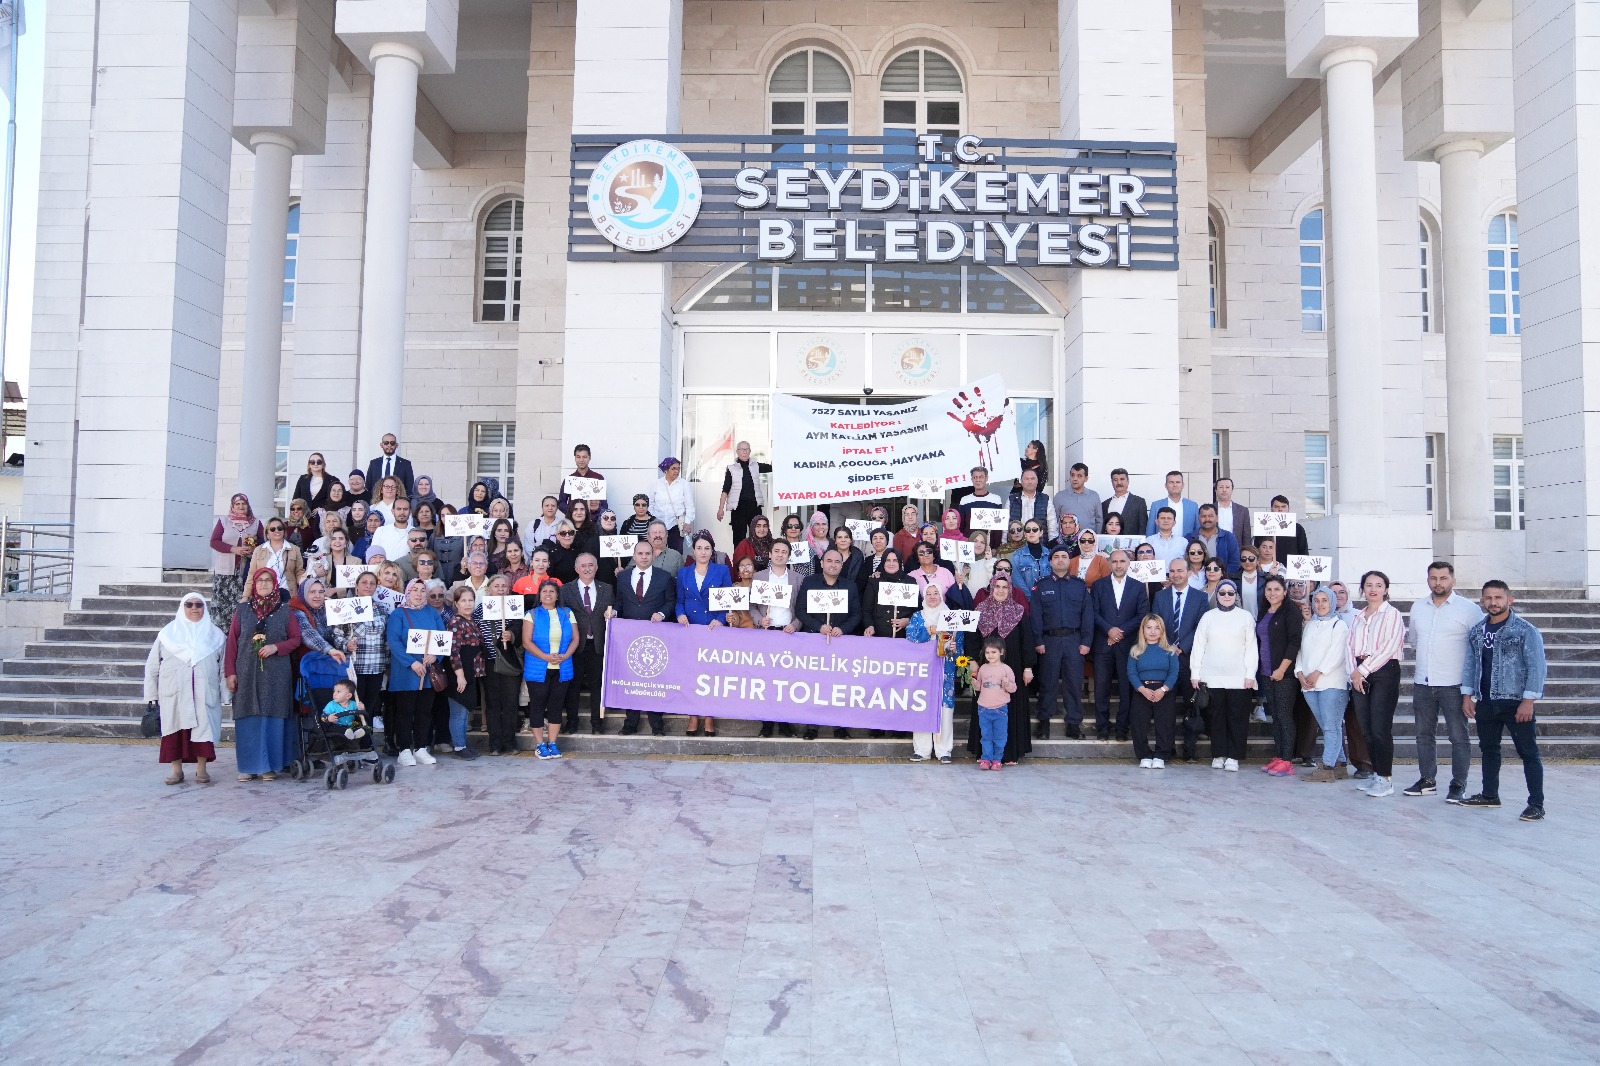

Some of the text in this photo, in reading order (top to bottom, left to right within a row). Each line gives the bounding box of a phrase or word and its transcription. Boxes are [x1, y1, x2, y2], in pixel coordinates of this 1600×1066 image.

[918, 134, 995, 163] T.C.
[734, 166, 1149, 216] SEYDİKEMER
[597, 213, 691, 247] BELEDİYESİ
[757, 217, 1132, 267] BELEDİYESİ
[830, 420, 896, 430] KATLEDİYOR
[806, 431, 829, 440] AYM
[842, 446, 873, 455] İPTAL
[875, 446, 889, 454] ET
[793, 460, 836, 469] KADINA
[847, 473, 894, 483] ŞİDDETE
[778, 491, 817, 500] YATARI
[819, 490, 850, 499] OLAN
[852, 486, 886, 496] HAPİS
[697, 647, 929, 678] KADINA YÖNELİK ŞİDDETE
[631, 681, 657, 689] GENÇLİK
[694, 673, 927, 712] SIFIR TOLERANS
